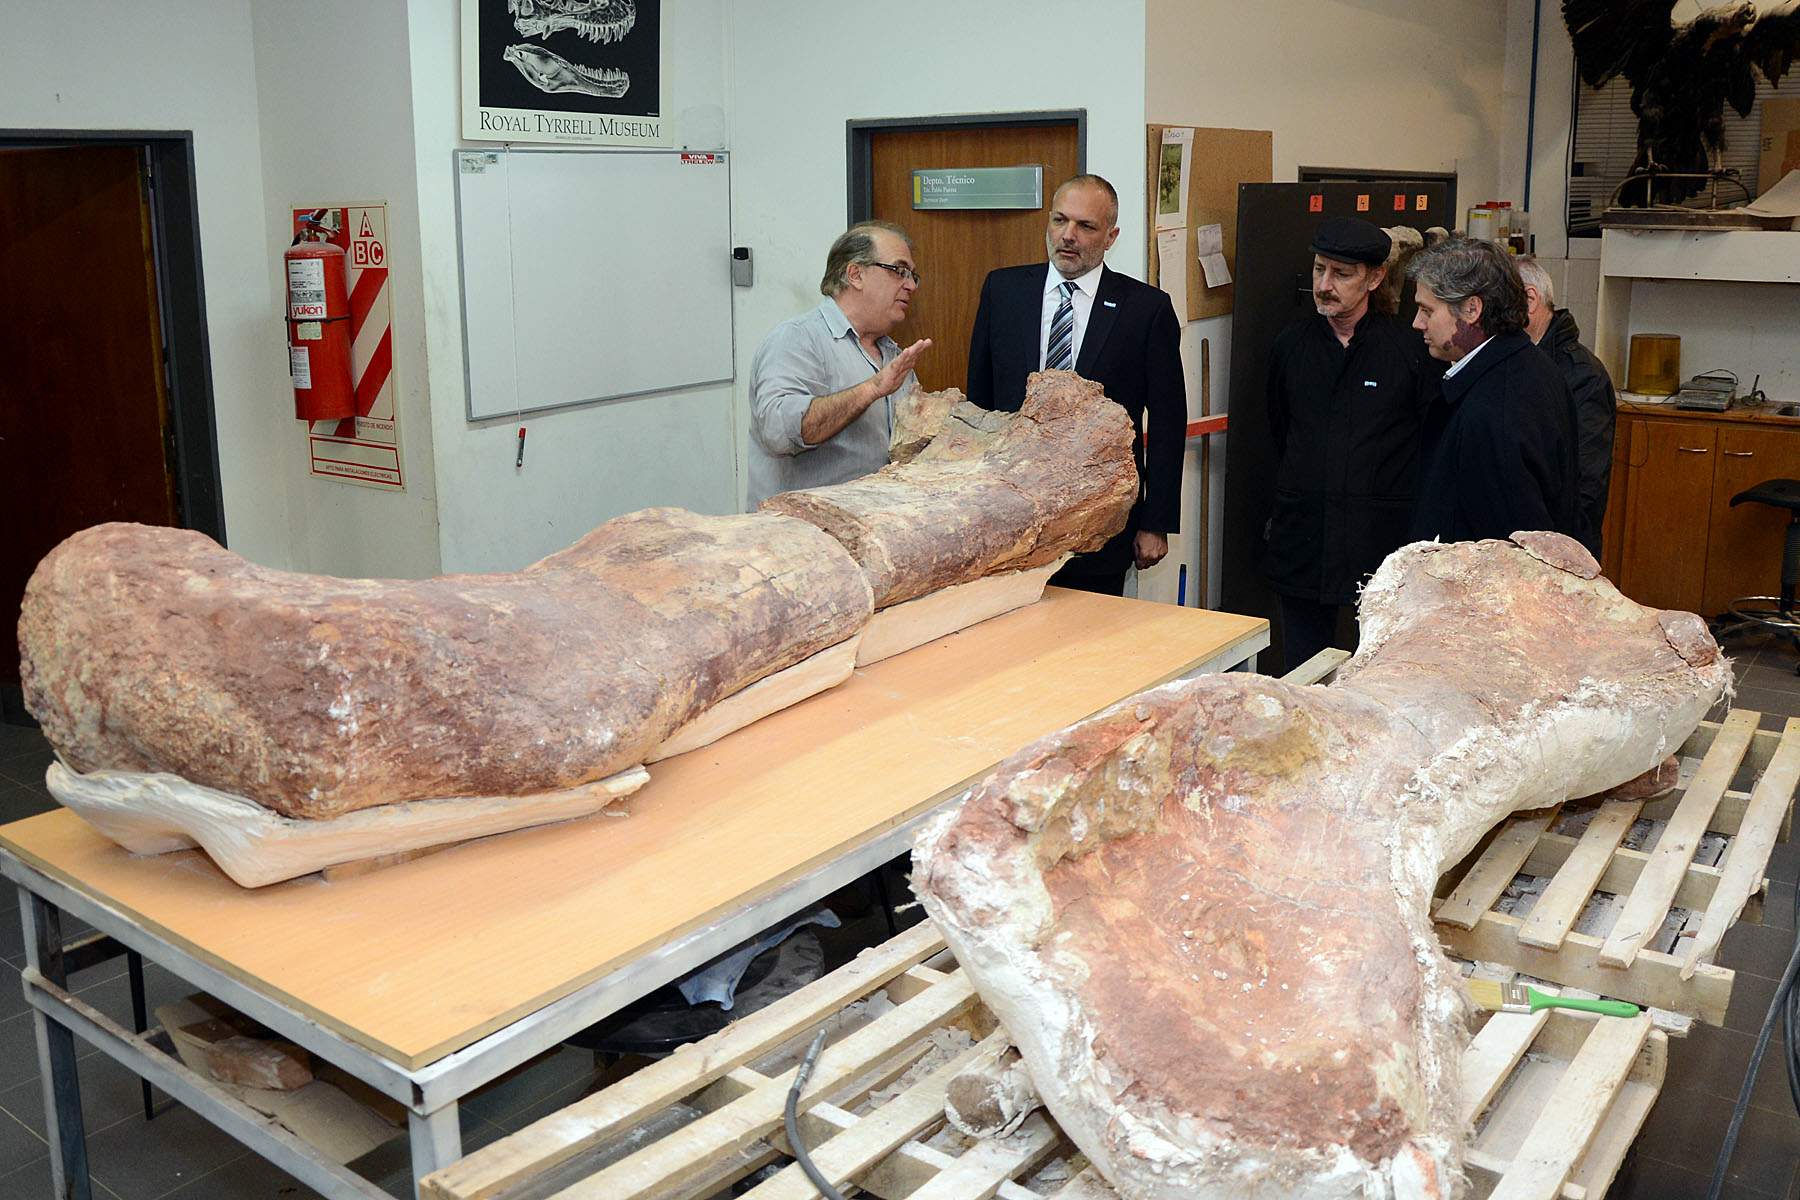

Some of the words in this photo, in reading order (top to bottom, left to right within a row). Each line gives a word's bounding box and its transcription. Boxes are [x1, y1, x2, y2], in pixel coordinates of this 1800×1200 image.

[479, 110, 531, 133] ROYAL
[533, 113, 596, 136] TYRRELL
[599, 117, 660, 139] MUSEUM
[946, 175, 975, 185] Técnico
[360, 211, 374, 237] A
[292, 304, 323, 317] yukon
